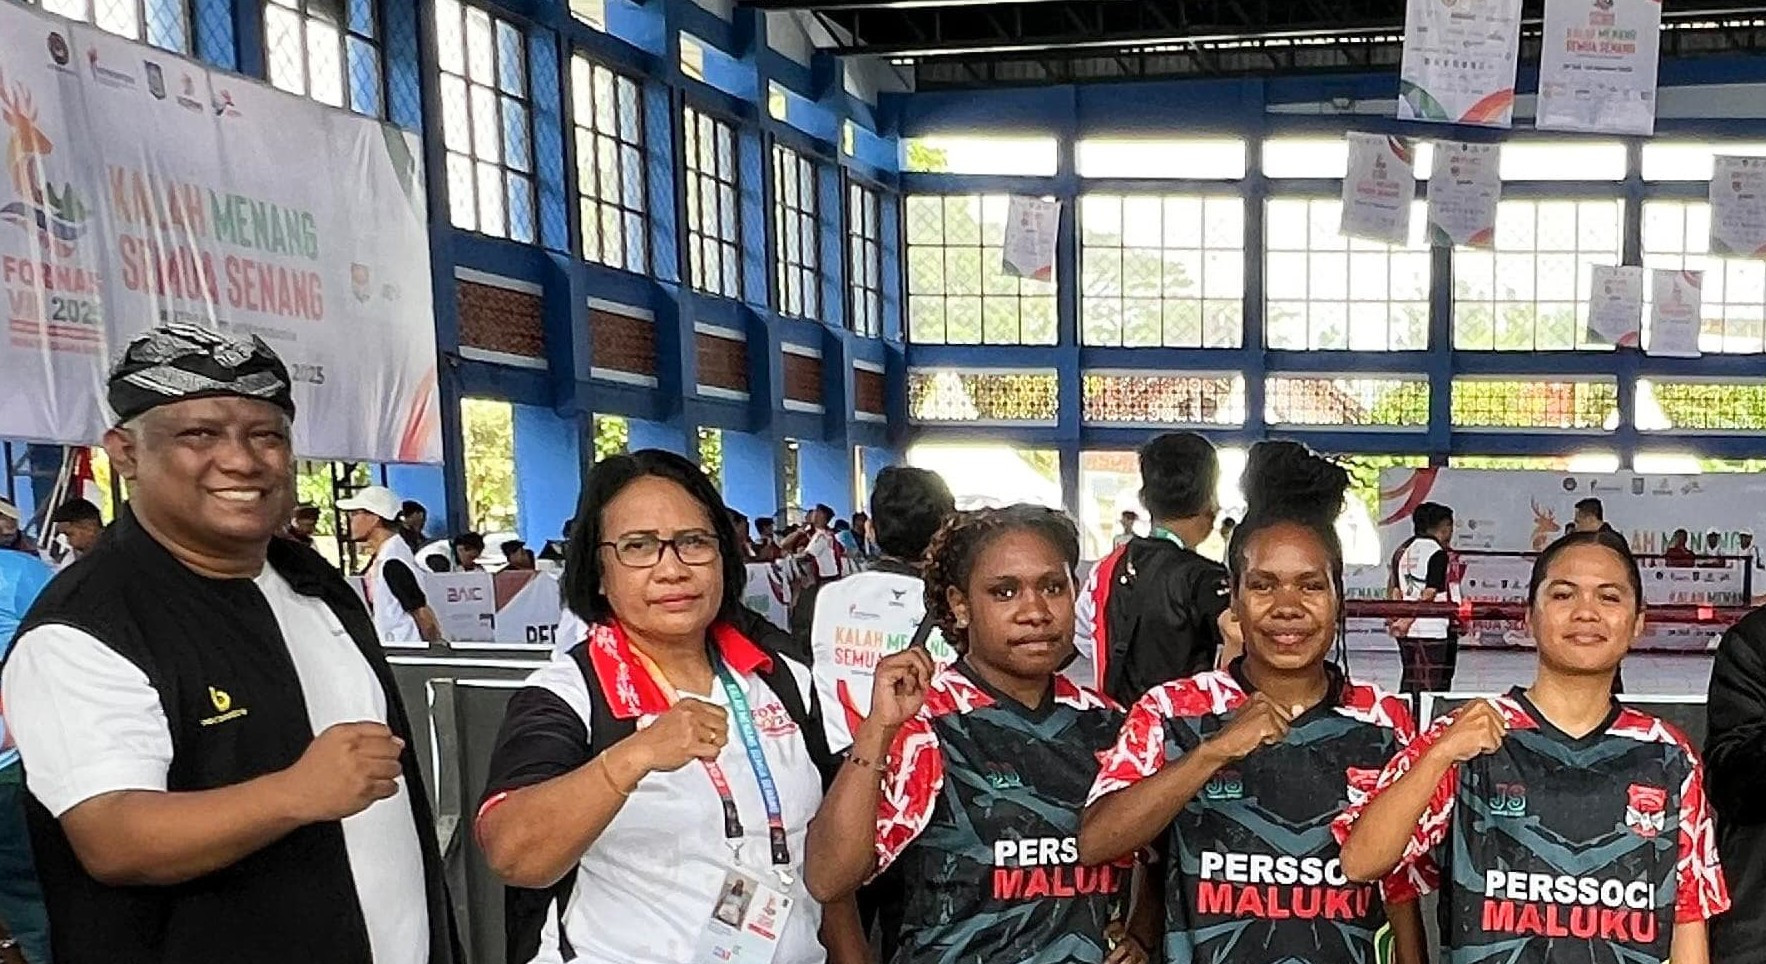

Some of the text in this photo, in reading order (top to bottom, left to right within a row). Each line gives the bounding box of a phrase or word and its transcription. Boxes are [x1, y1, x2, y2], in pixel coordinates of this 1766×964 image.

[109, 165, 318, 260] KALAH MENANG
[118, 233, 324, 321] SEMUA SENANG
[1662, 531, 1743, 552] MNNG
[835, 627, 949, 658] KALAH MENG
[994, 837, 1078, 867] PERS
[1200, 851, 1348, 886] PERSSO
[1485, 869, 1655, 910] PERSSOCI
[1482, 900, 1658, 943] MALUKU
